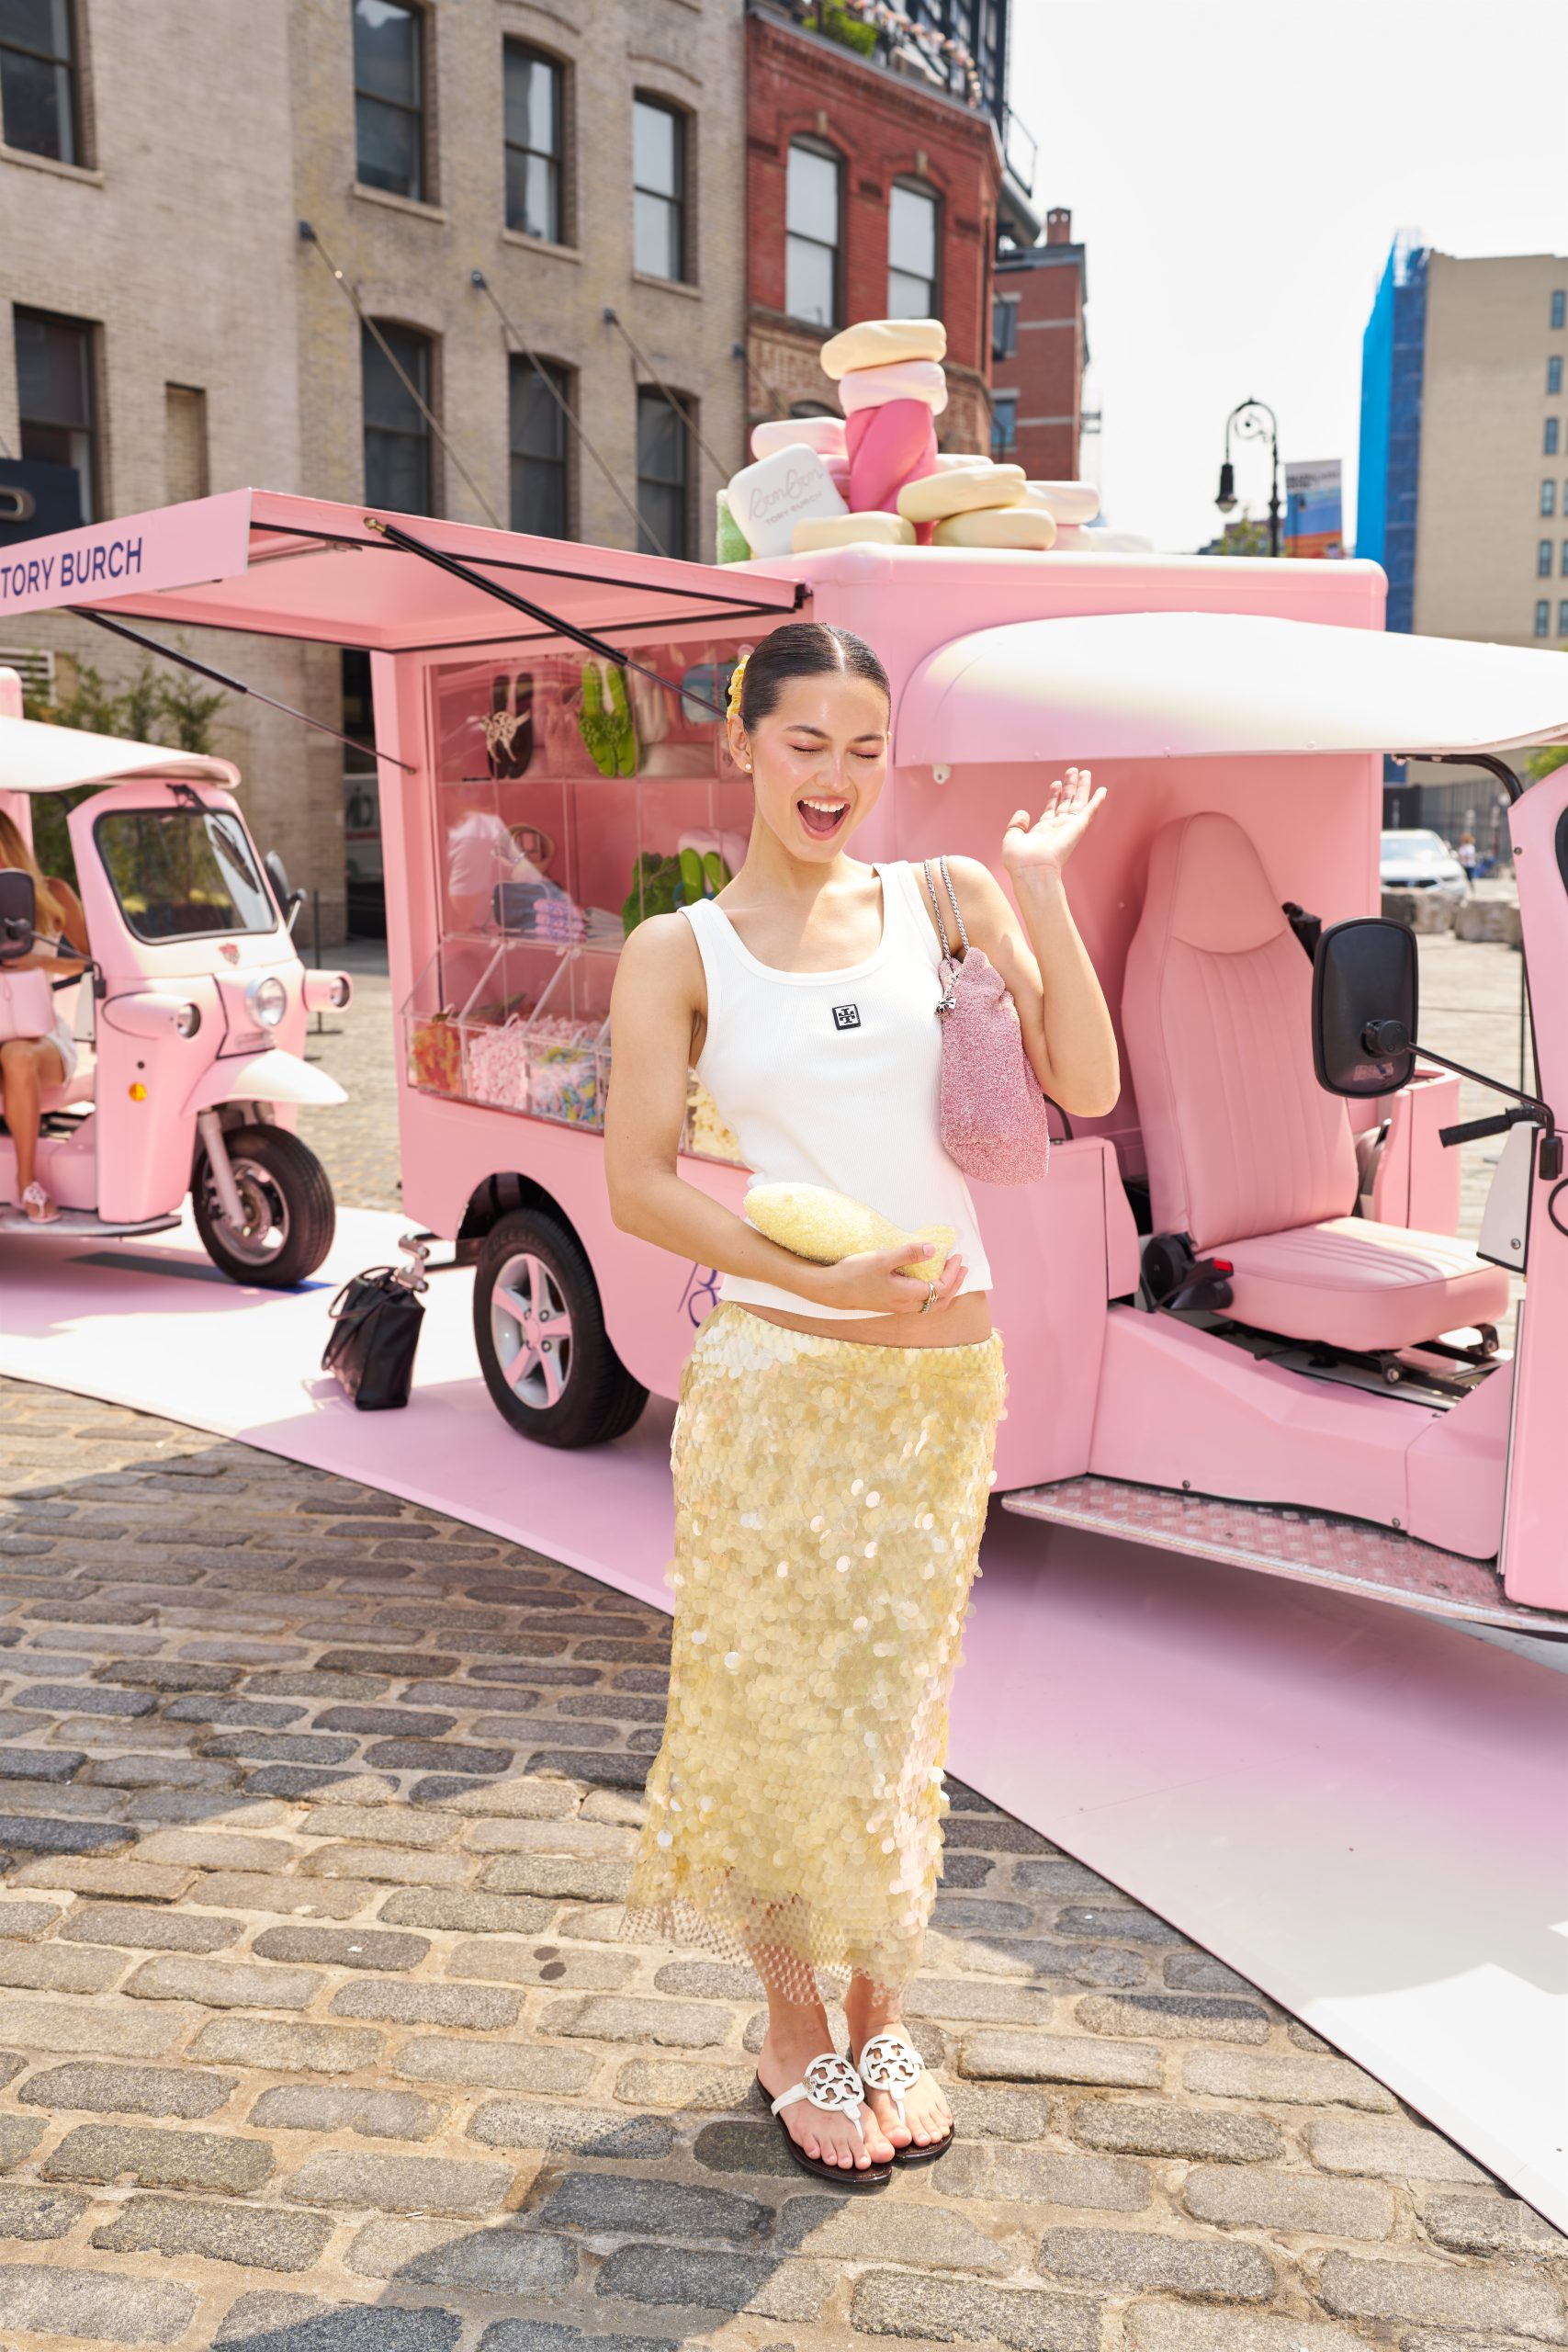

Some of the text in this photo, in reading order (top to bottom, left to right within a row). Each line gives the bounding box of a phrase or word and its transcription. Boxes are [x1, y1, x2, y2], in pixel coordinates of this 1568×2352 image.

[764, 509, 789, 525] TORY
[1, 537, 142, 598] TORY BURCH
